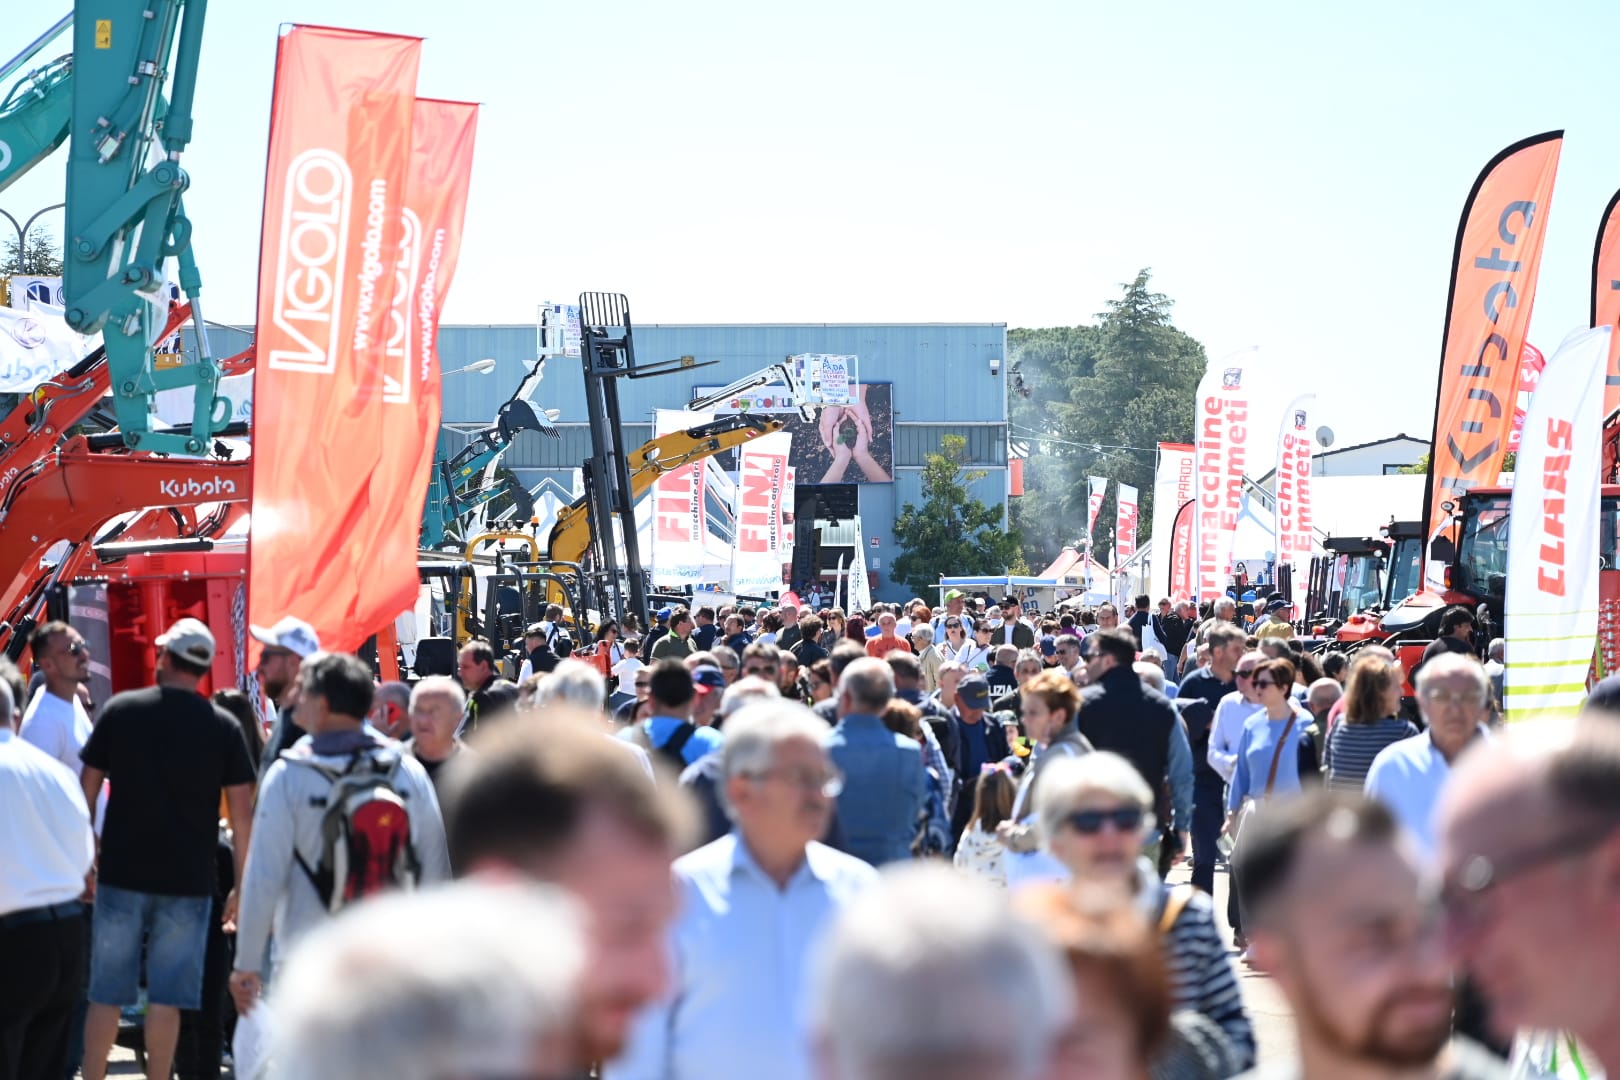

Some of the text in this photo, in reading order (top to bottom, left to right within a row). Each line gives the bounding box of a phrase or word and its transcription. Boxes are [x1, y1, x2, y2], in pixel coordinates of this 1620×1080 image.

[270, 150, 352, 374] VIGOLO
[353, 178, 387, 351] www.vigolo.com
[420, 228, 446, 382] www.vigolo.com
[1440, 200, 1538, 489] Kubota
[730, 395, 795, 412] agricoltu
[160, 476, 236, 497] Kubota
[657, 462, 691, 542] FIN
[691, 463, 701, 540] macchine agri
[1178, 458, 1193, 509] SPARDO
[1220, 400, 1248, 531] Emmeti
[1294, 438, 1312, 552] Emmeti
[768, 502, 777, 550] macchine
[1537, 417, 1573, 597] CLAAS
[1174, 524, 1191, 587] SICMA
[987, 684, 1012, 697] LIZIA
